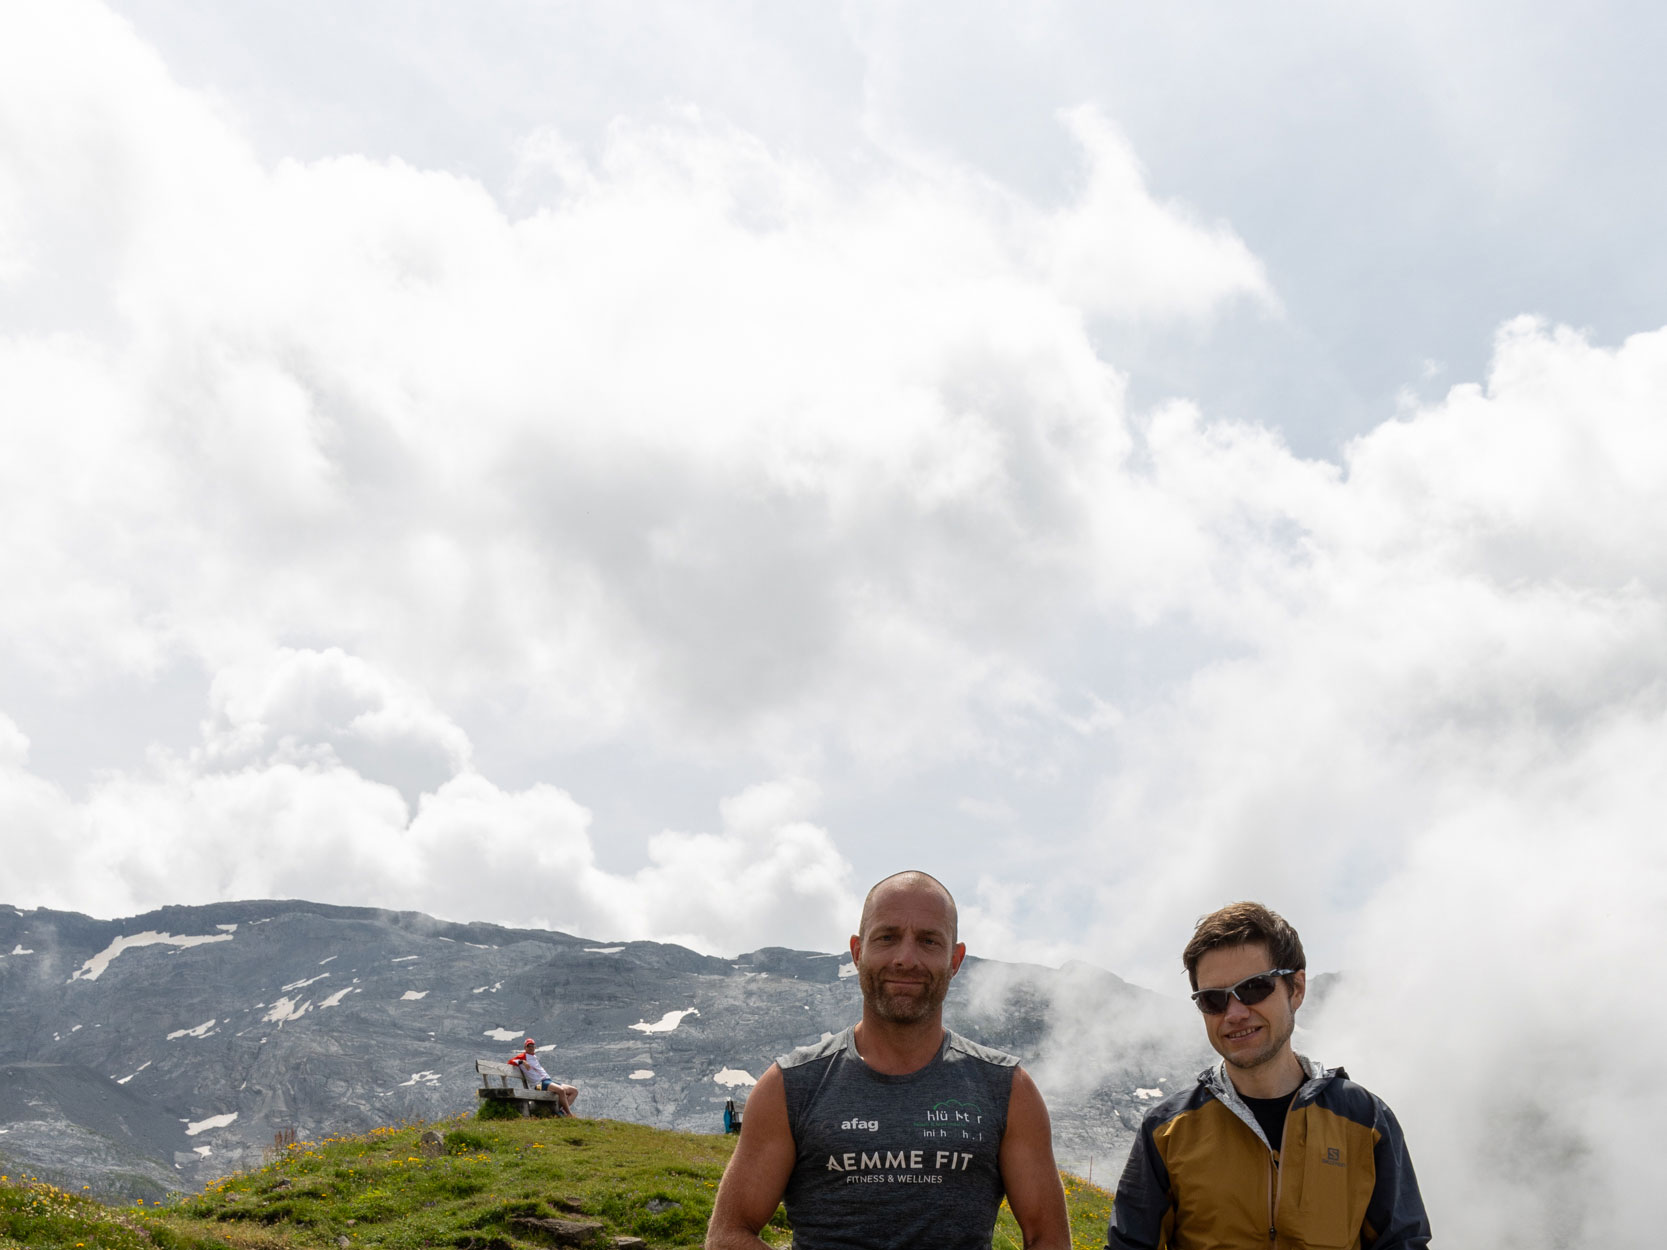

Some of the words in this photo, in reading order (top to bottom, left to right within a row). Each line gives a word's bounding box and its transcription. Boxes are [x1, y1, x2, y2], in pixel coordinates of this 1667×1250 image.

[841, 1117, 879, 1132] afag
[826, 1151, 924, 1171] AEMME
[935, 1151, 973, 1171] FIT
[846, 1174, 885, 1184] FITNESS
[887, 1174, 895, 1183] &
[897, 1174, 943, 1184] WELLNES
